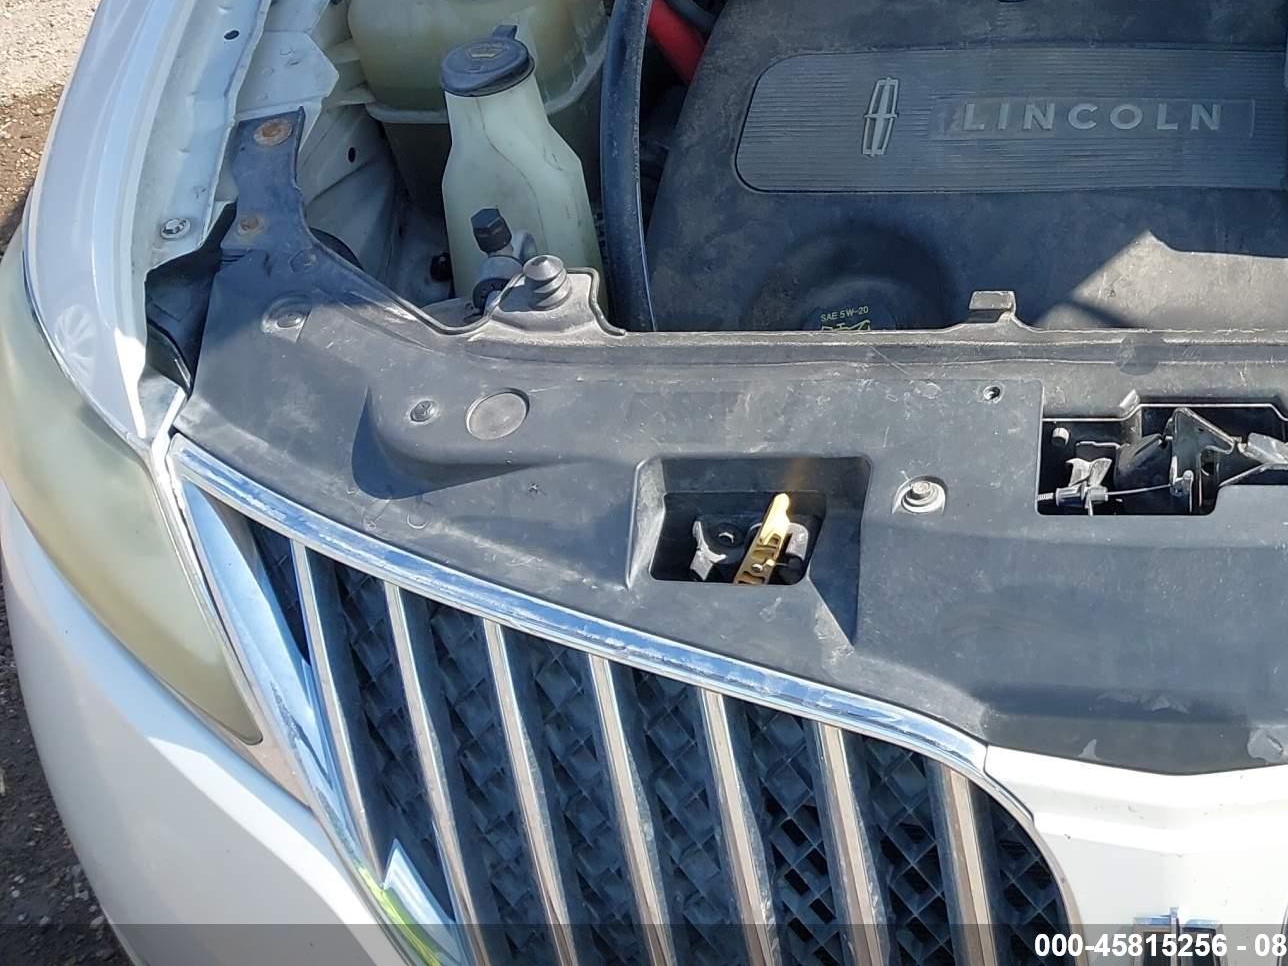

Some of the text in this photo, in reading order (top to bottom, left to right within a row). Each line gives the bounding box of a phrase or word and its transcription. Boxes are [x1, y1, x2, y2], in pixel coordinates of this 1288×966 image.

[963, 103, 1222, 131] LINCOLN
[820, 305, 869, 323] SAE 5W-20
